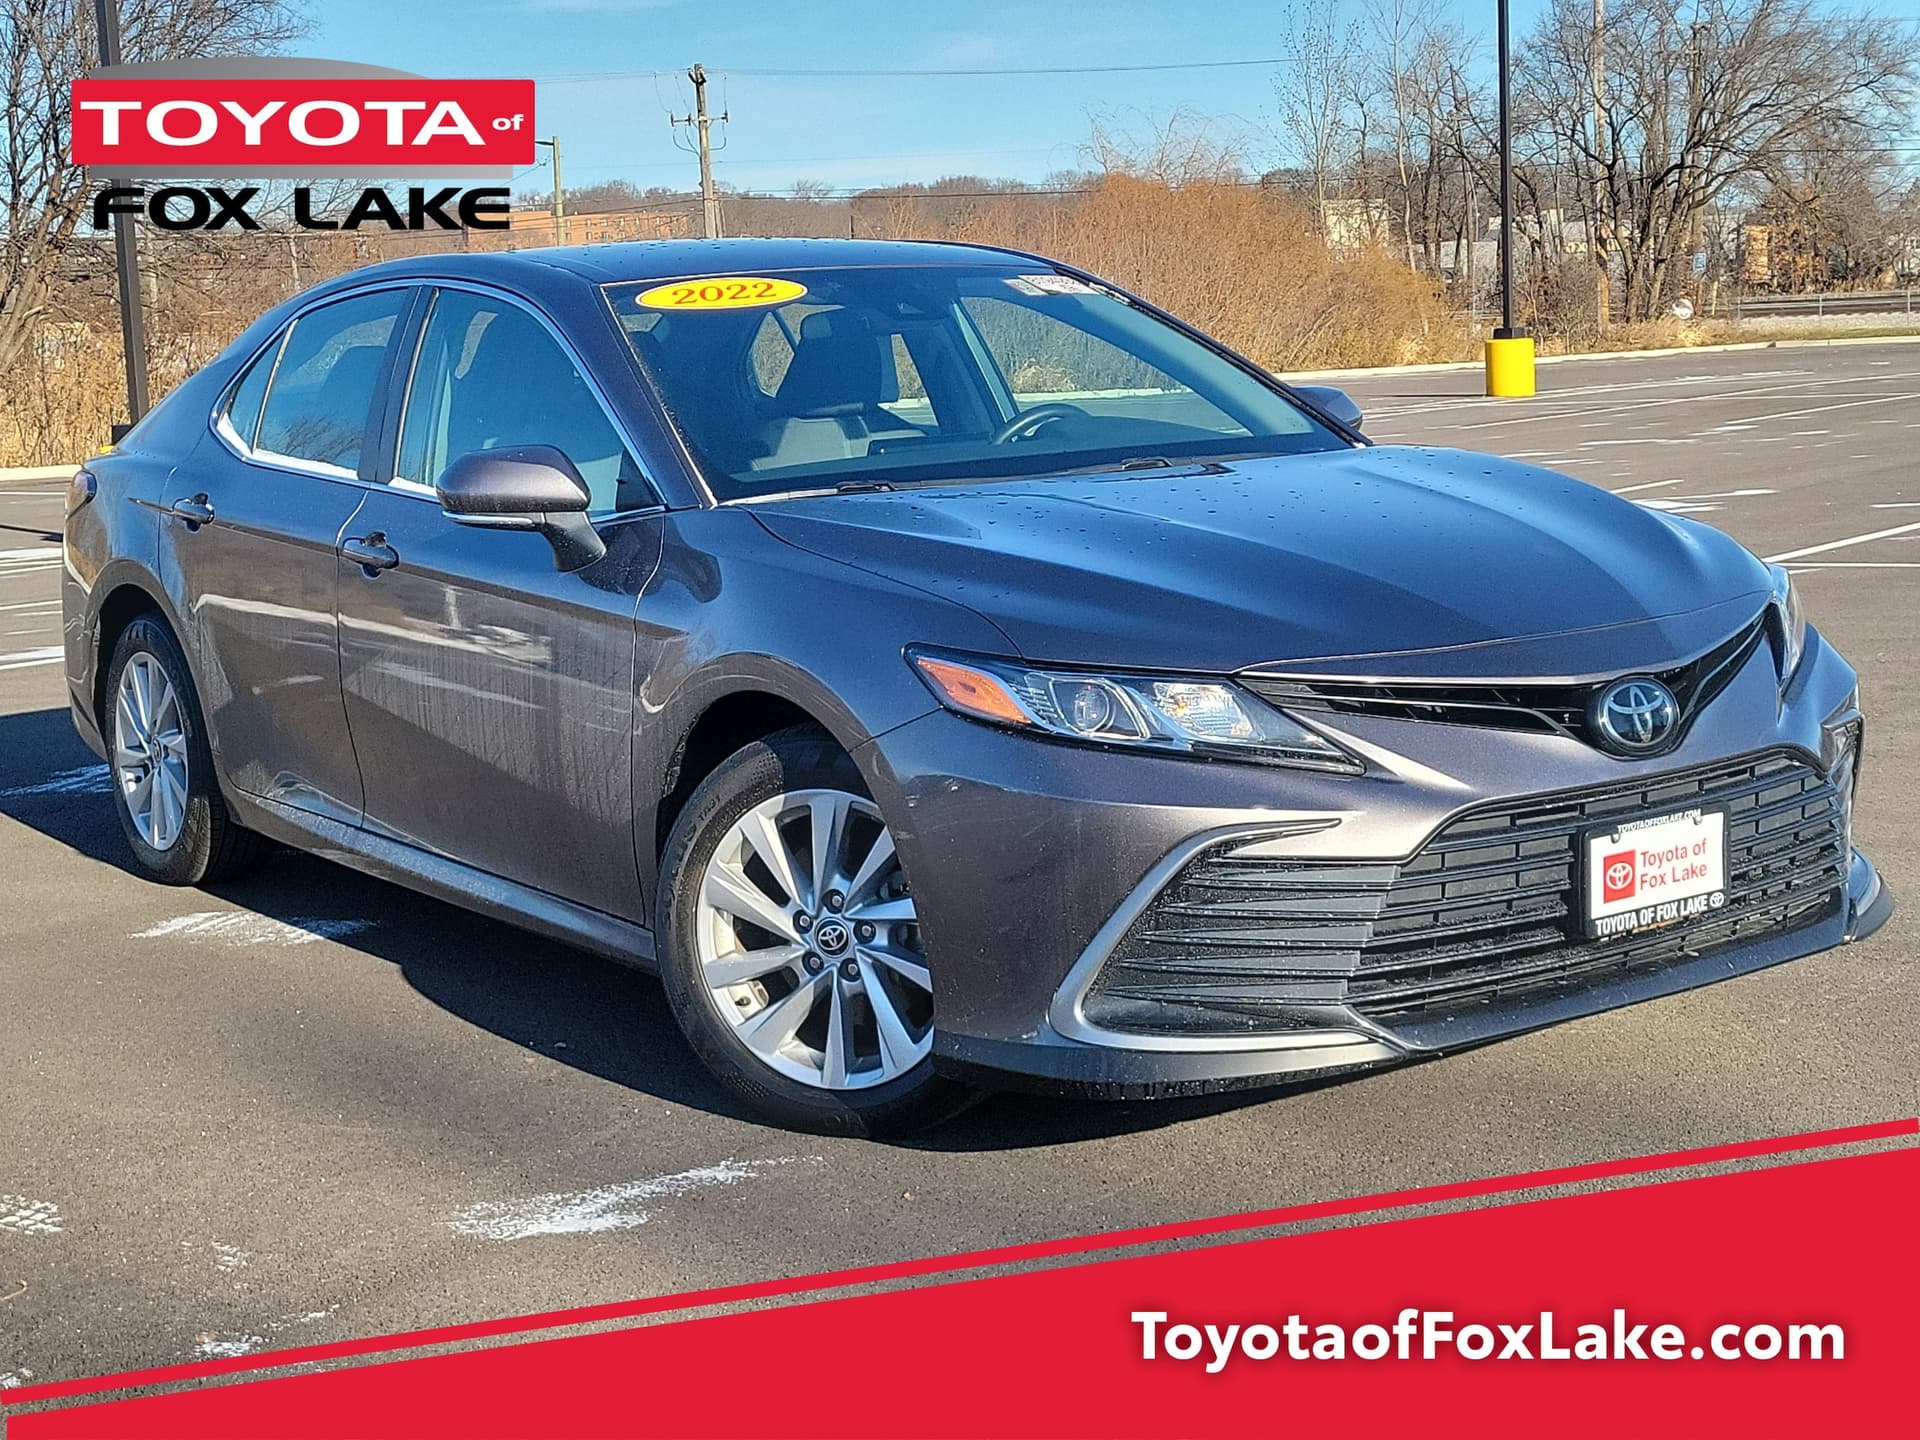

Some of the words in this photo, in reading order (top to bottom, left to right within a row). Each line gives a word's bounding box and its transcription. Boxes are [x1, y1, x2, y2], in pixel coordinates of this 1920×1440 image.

[672, 282, 777, 305] 2022
[1640, 844, 1687, 869] Toyota
[1692, 837, 1708, 855] of
[1640, 871, 1666, 890] Fox
[1672, 862, 1708, 883] Lake
[1595, 911, 1638, 936] TOYOTA
[1640, 906, 1655, 925] OF
[1657, 901, 1678, 921] FOX
[1680, 894, 1708, 916] LAKE
